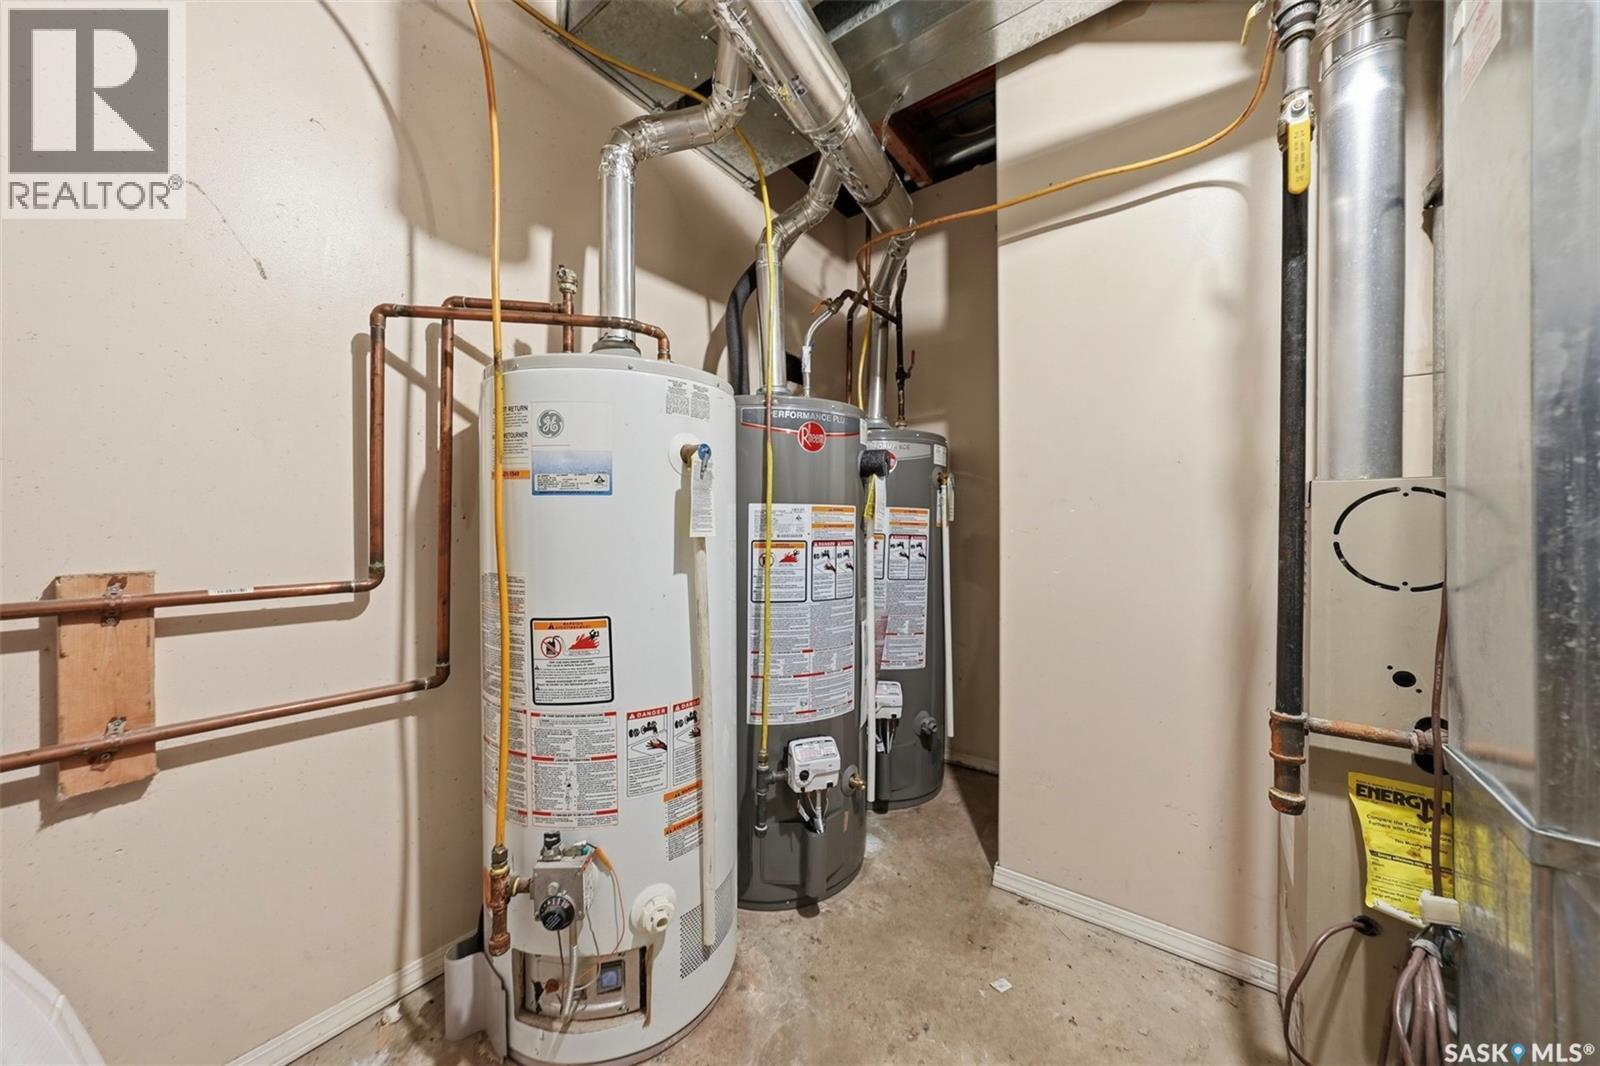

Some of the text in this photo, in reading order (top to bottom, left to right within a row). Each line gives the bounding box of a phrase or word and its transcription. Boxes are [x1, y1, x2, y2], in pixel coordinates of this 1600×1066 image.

[770, 410, 832, 423] ERFORMANCE
[636, 708, 666, 718] DANGER
[1404, 821, 1427, 832] Energy
